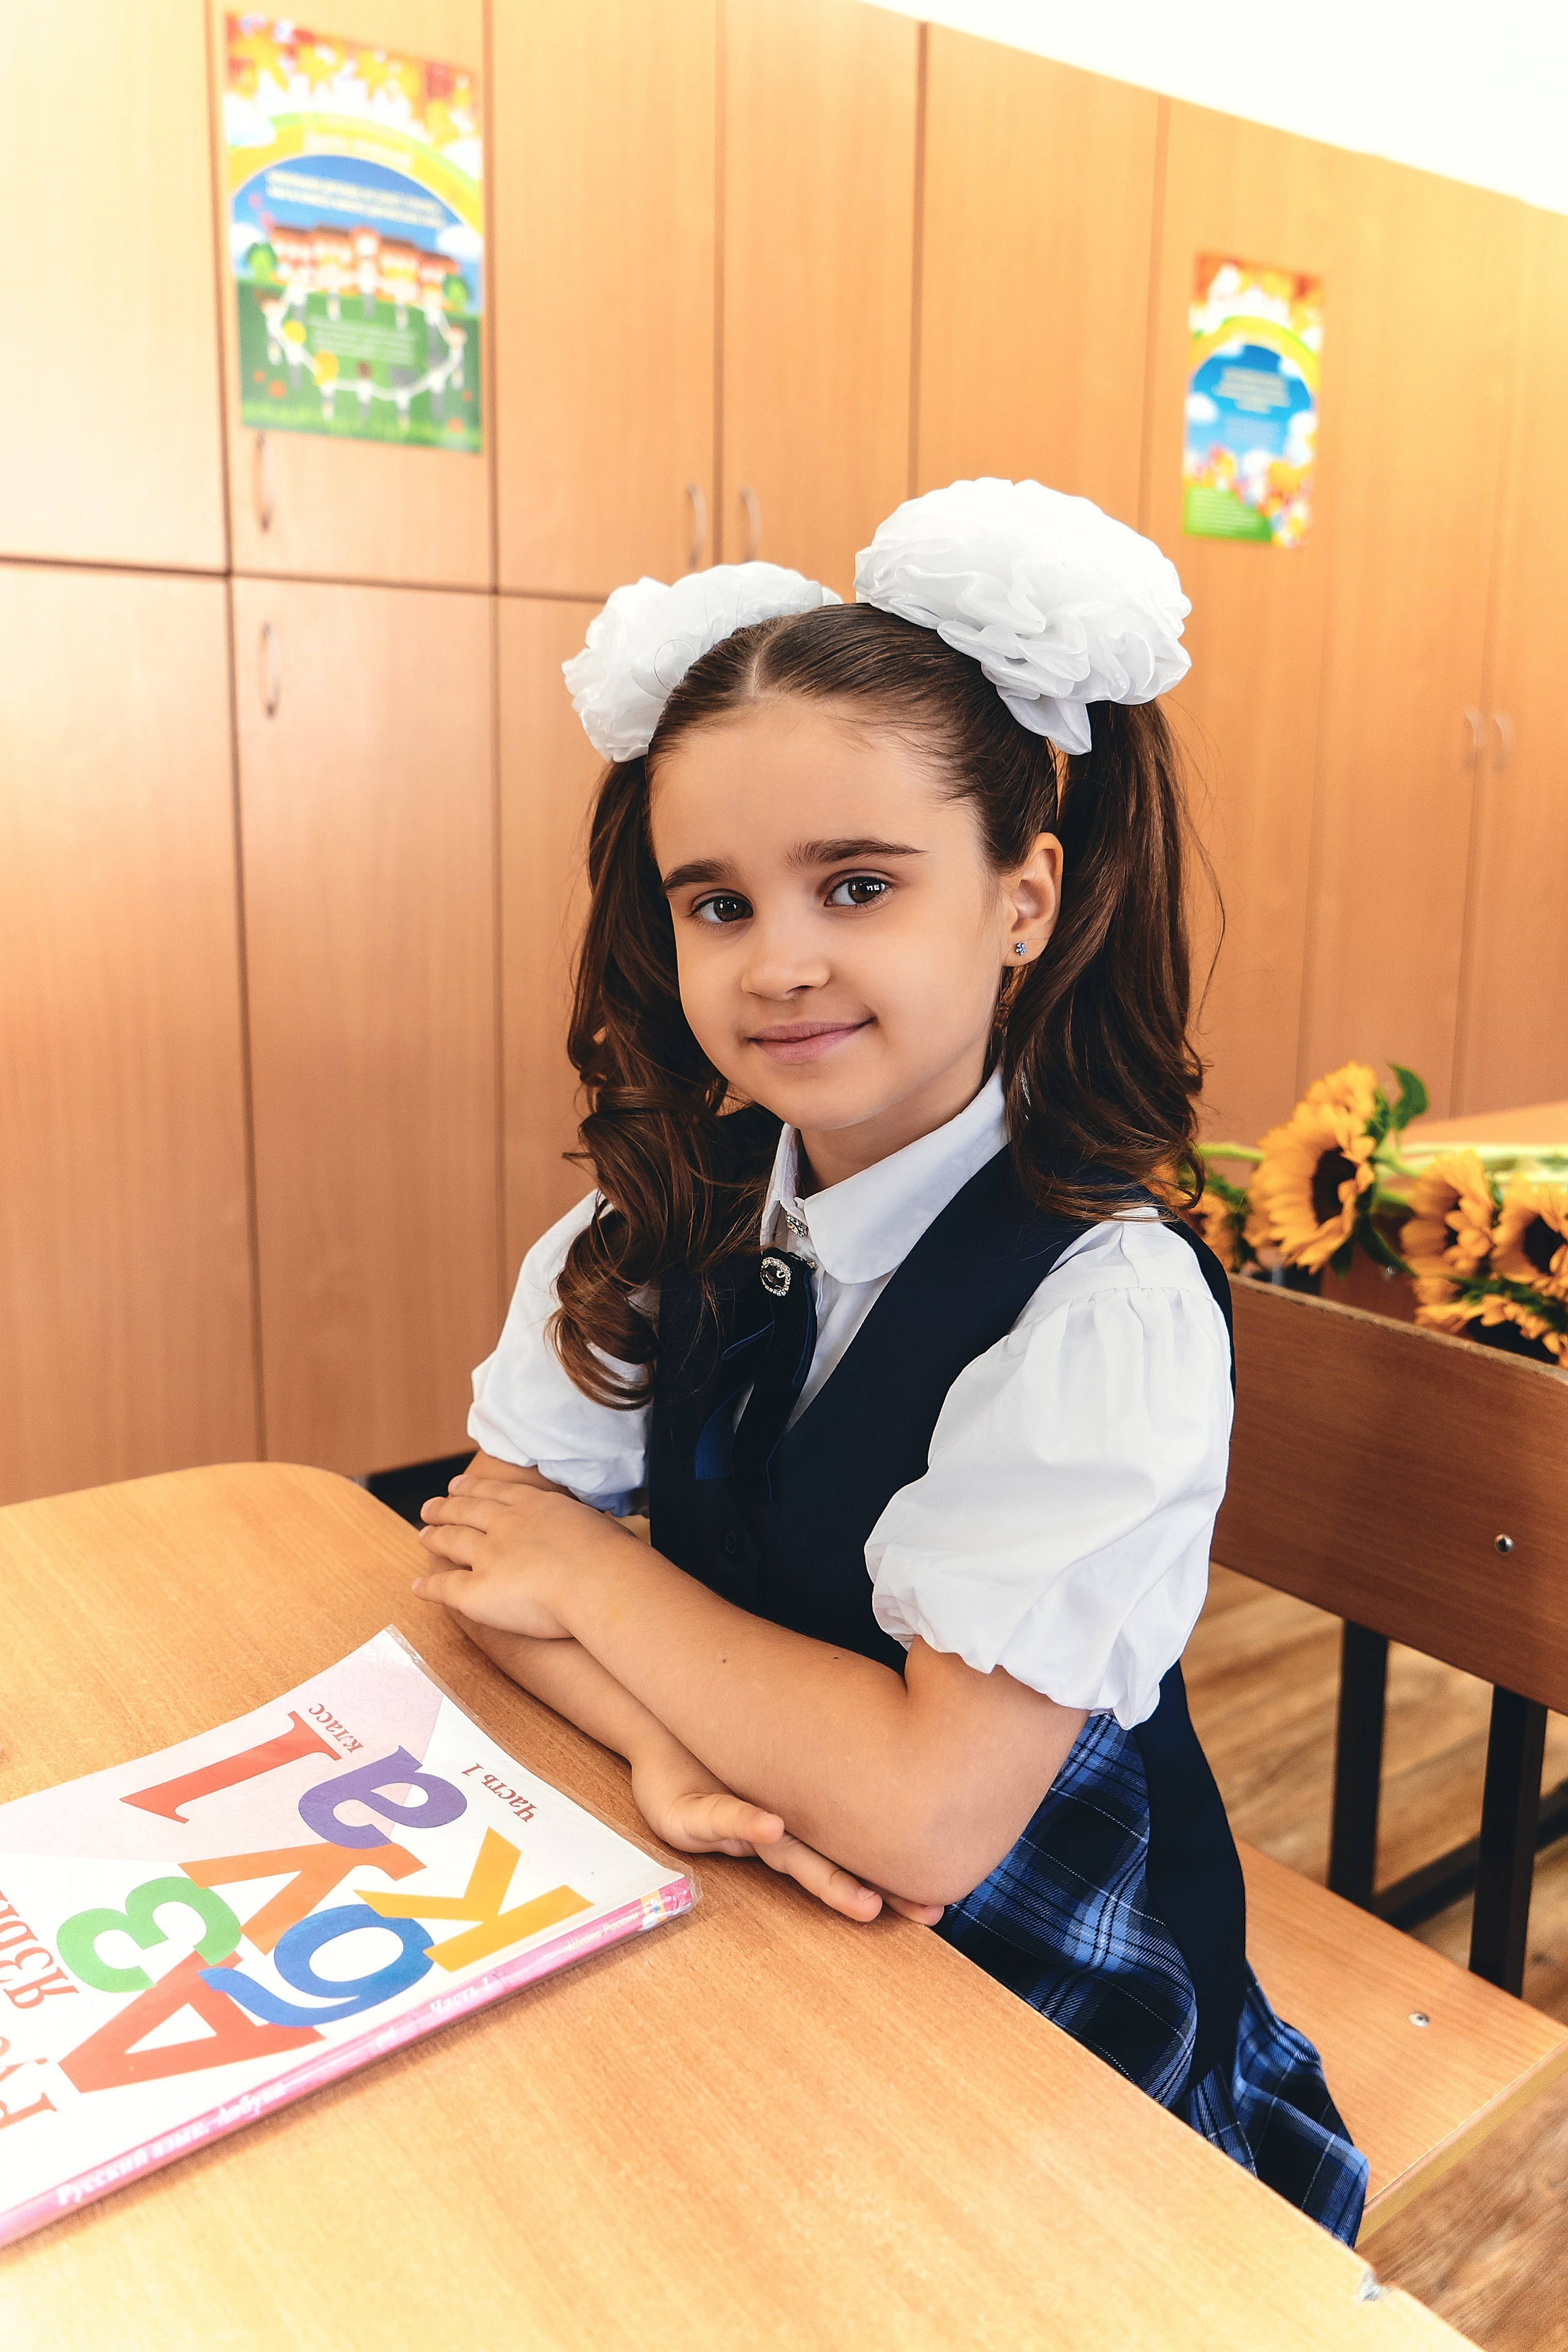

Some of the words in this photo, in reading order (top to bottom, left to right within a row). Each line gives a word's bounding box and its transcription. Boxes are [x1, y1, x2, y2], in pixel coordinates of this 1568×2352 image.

[119, 1710, 342, 1824] 1
[309, 1703, 364, 1754] класс
[461, 1763, 484, 1777] 1
[481, 1773, 538, 1823] Часть
[430, 1985, 480, 2015] Часть
